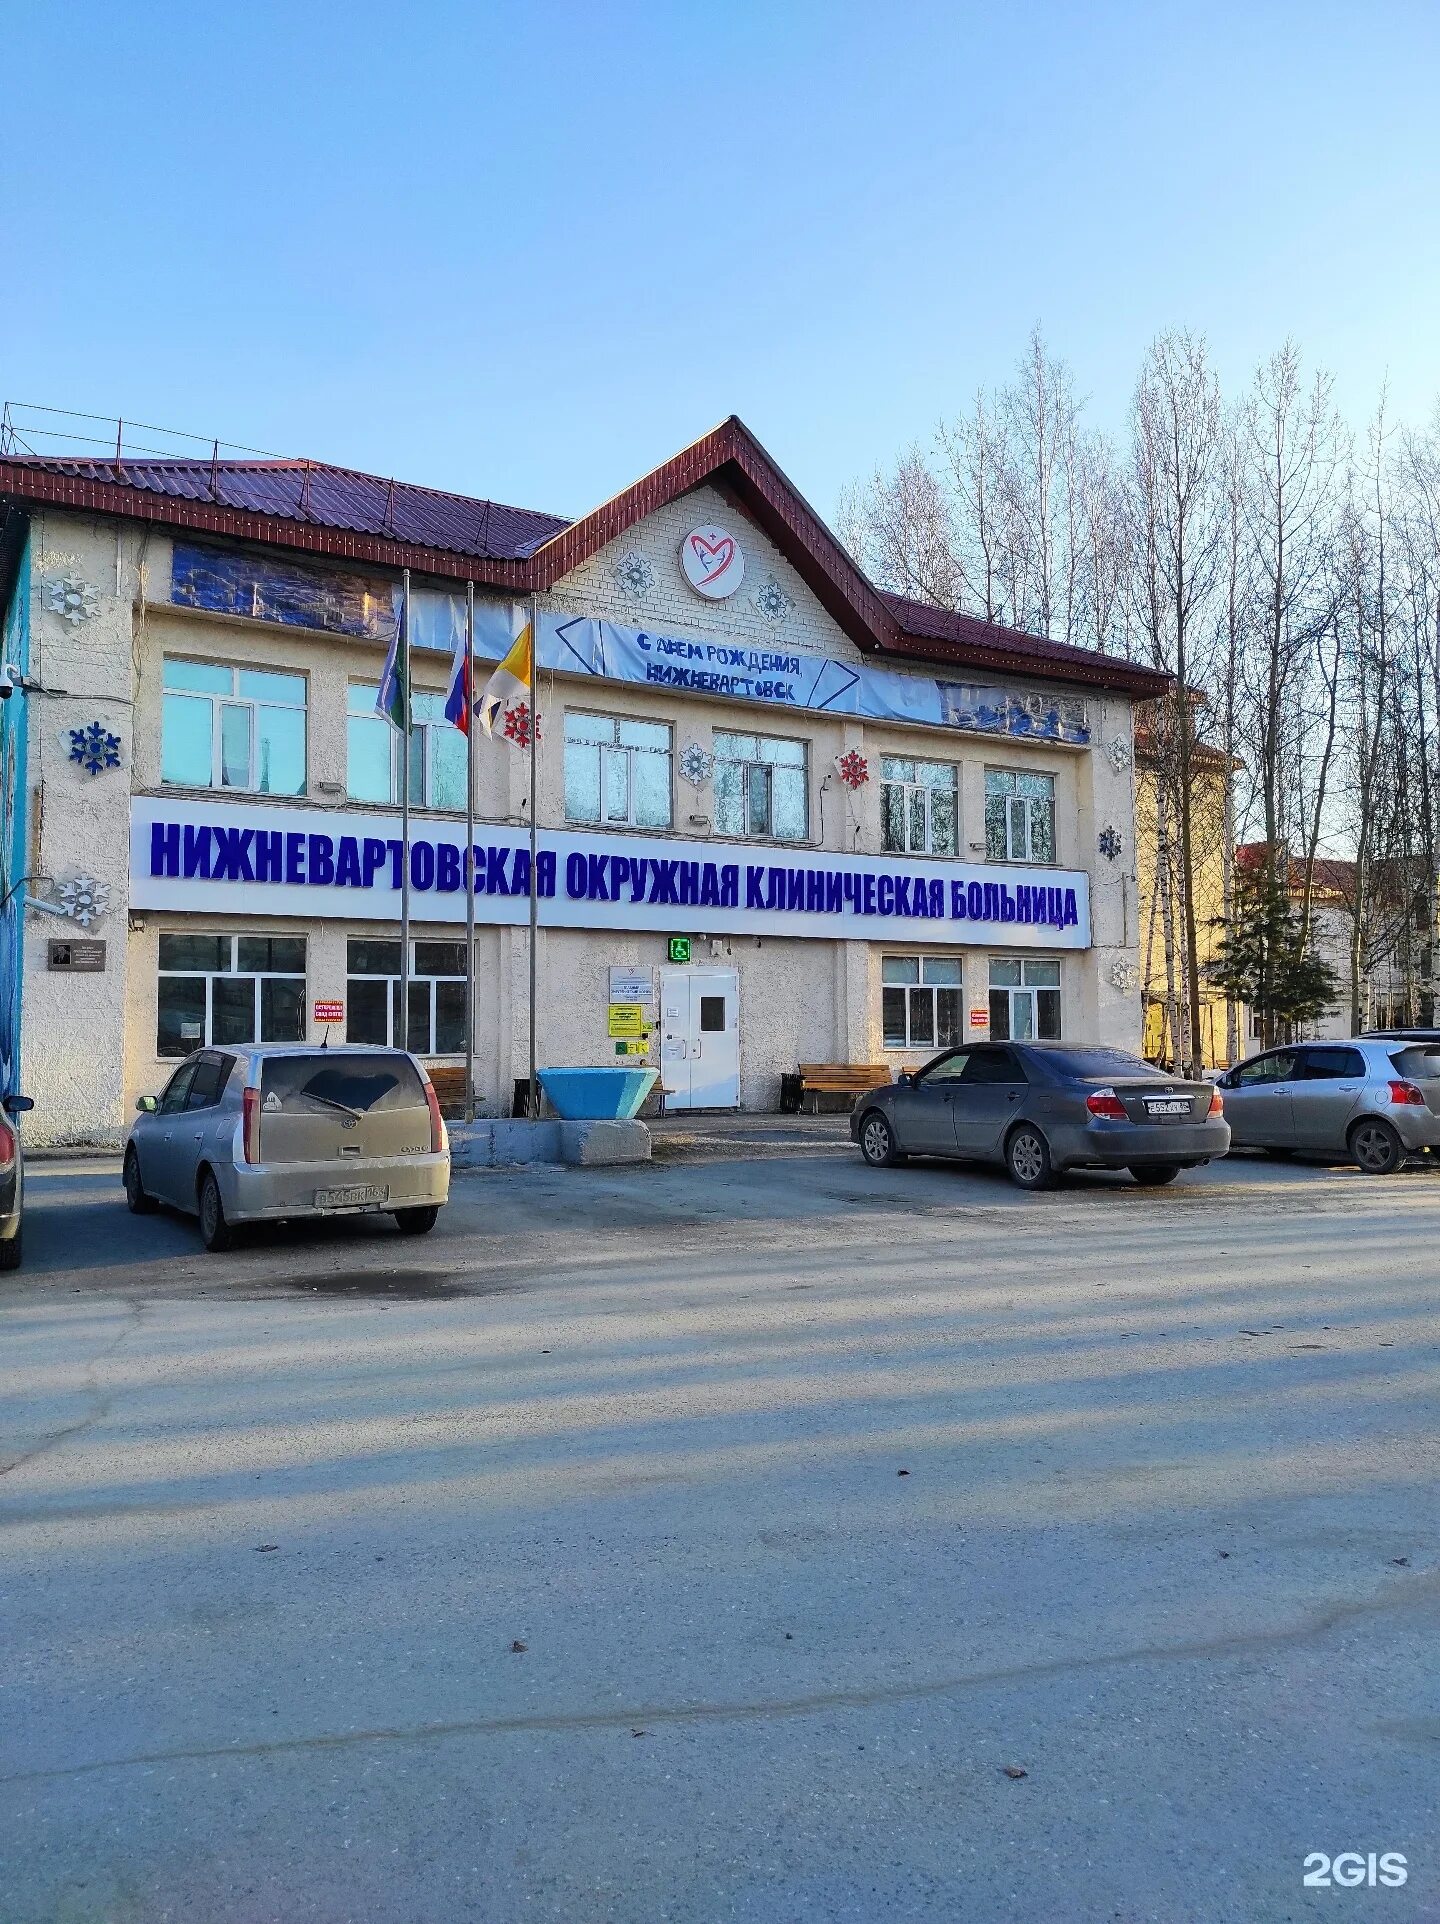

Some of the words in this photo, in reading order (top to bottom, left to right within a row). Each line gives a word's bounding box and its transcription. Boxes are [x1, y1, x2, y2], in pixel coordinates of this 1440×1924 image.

[637, 633, 651, 651] С
[656, 638, 703, 660] ДНЕМ
[707, 645, 803, 678] РОЖДЕНИЯ,
[646, 662, 796, 701] НИЖНЕВАРТОВСК
[150, 822, 557, 898] НИЖНЕВАРТОВСКАЯ
[566, 852, 740, 908] ОКРУЖНАЯ
[746, 865, 945, 919] КЛИНИЧЕСКАЯ
[950, 879, 1079, 929] БОЛЬНИЦА
